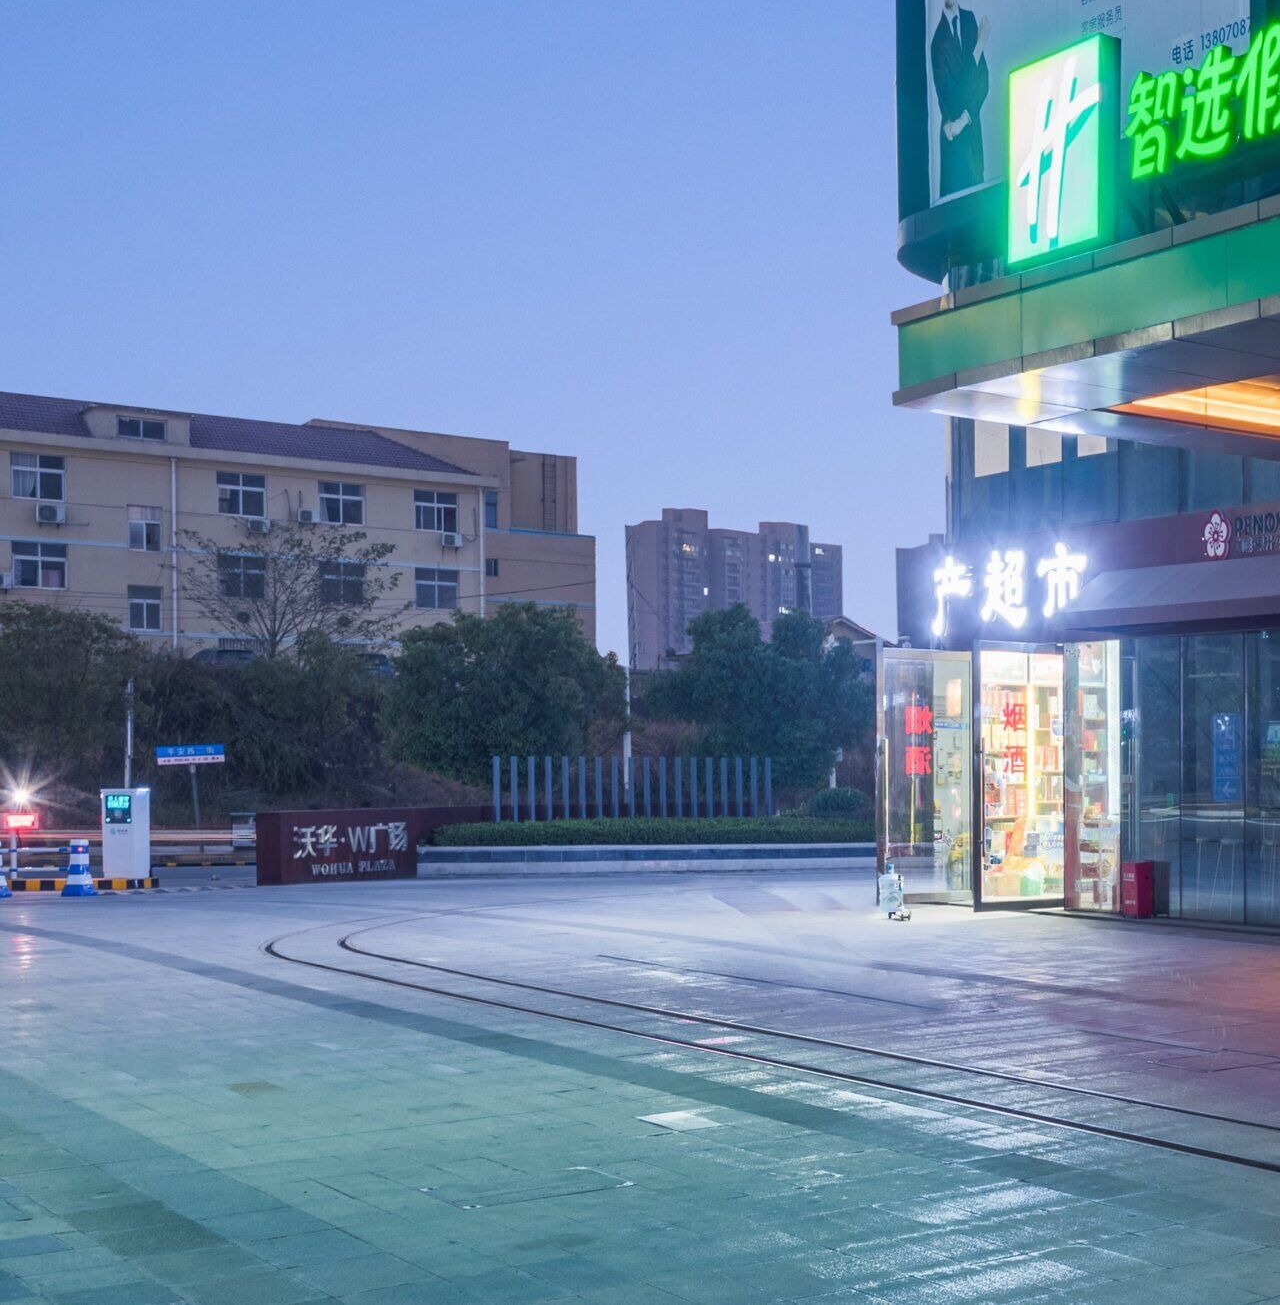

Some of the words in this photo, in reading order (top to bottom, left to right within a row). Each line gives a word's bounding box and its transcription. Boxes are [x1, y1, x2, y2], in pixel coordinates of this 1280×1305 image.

[1172, 39, 1194, 64] 电话
[931, 541, 1088, 637] 产超市
[1003, 701, 1026, 774] 烟酒
[293, 822, 408, 859] 沃华·W广场
[312, 863, 354, 875] WOHUA
[358, 859, 396, 872] PLAZA
